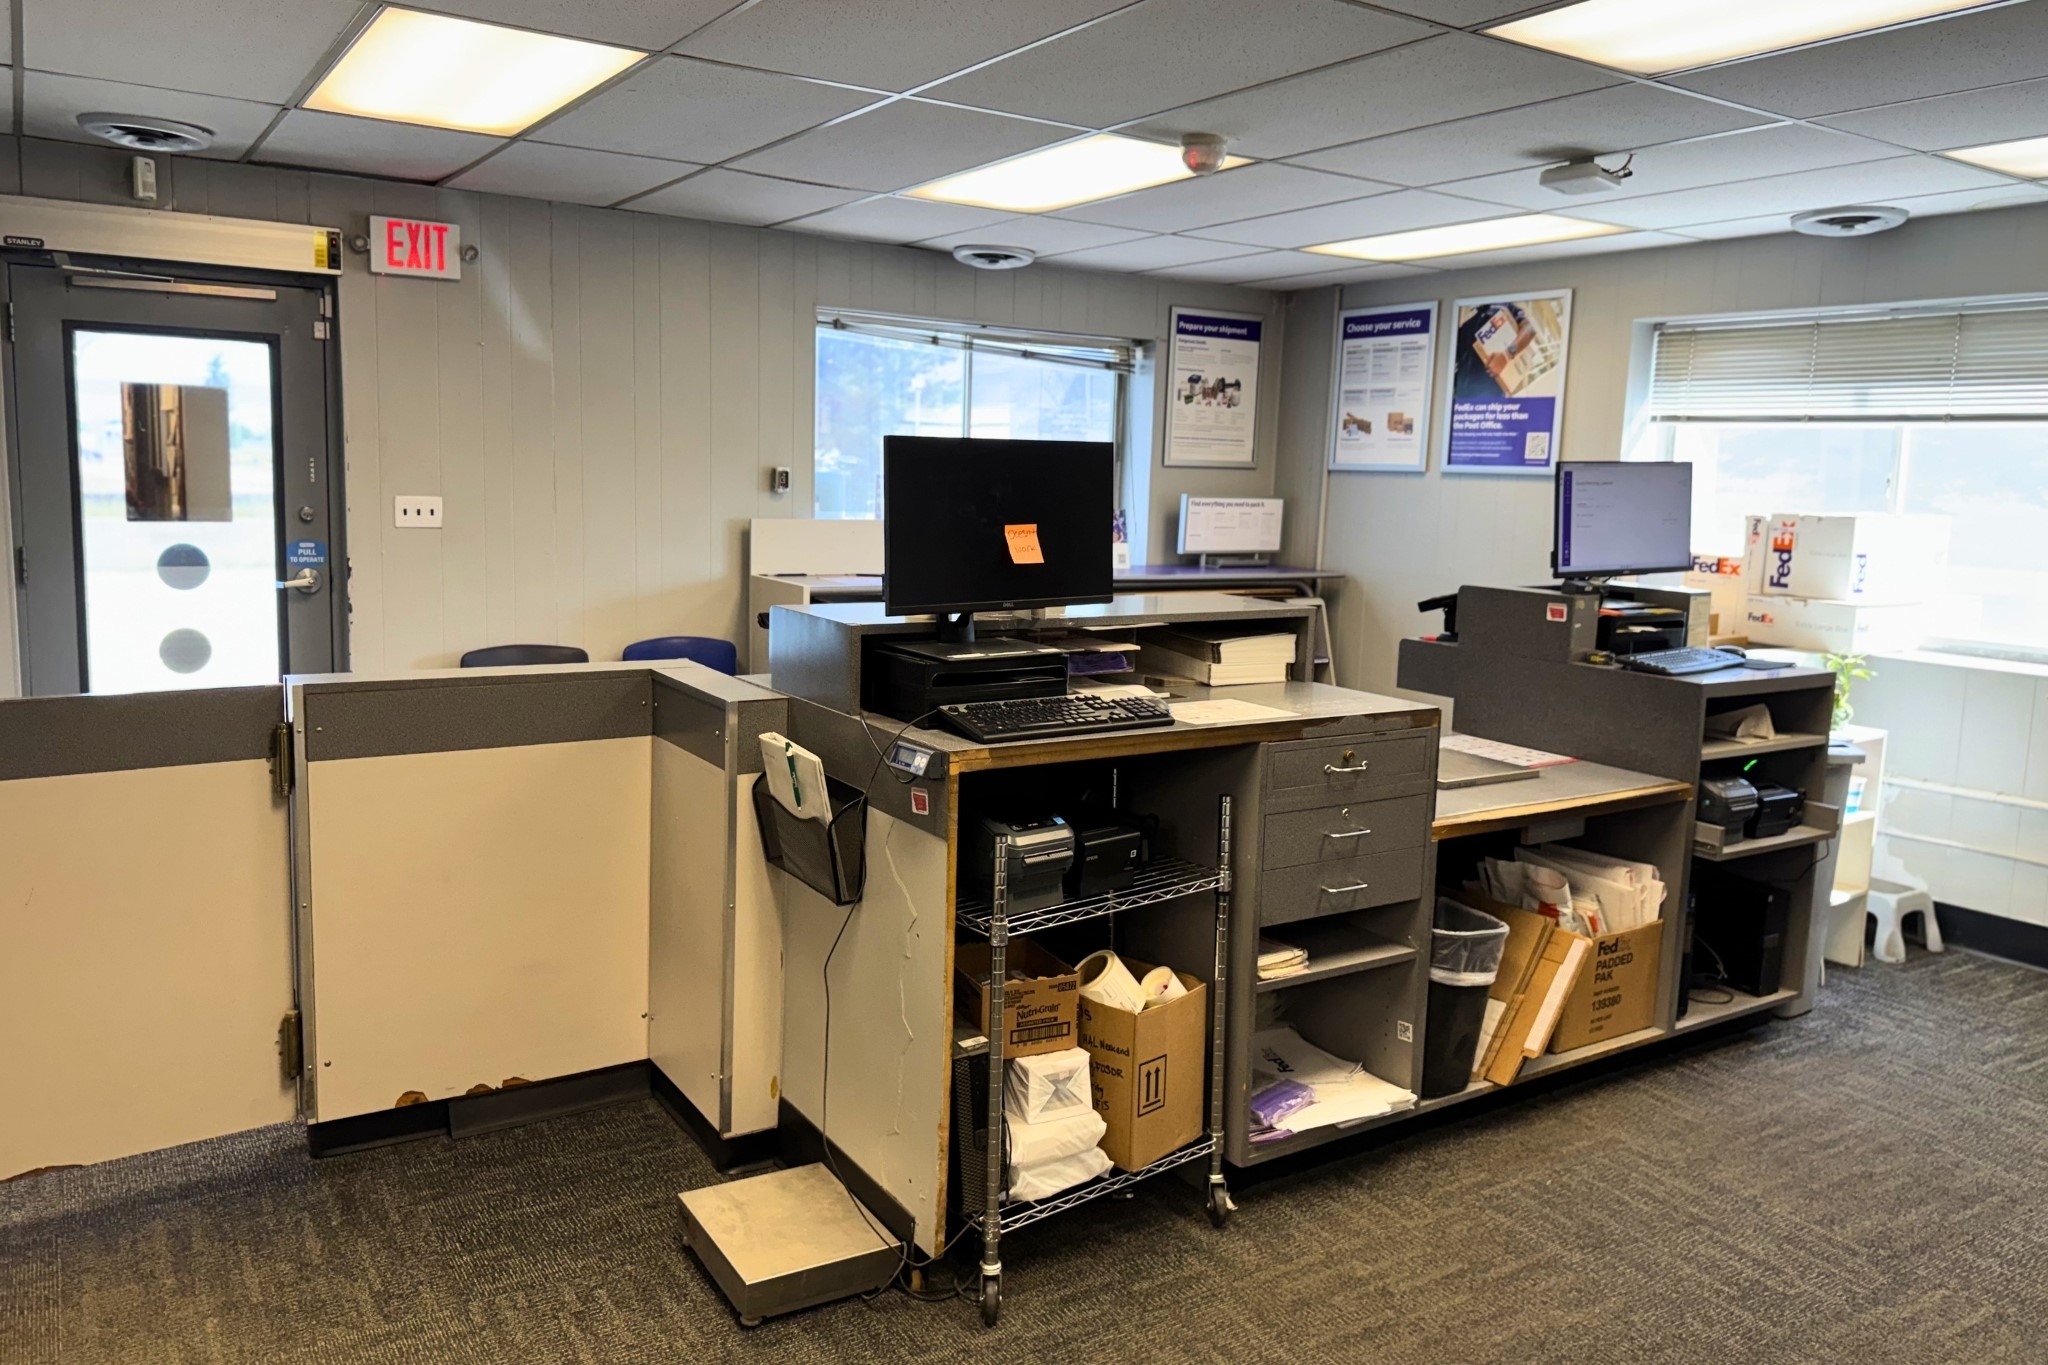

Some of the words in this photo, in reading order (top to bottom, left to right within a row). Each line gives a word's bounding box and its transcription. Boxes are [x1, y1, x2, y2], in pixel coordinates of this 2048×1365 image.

[7, 238, 41, 246] STANLEY
[387, 221, 448, 271] EXIT
[1179, 321, 1203, 332] Prepare
[1204, 325, 1218, 333] your
[1219, 325, 1248, 335] shipment
[1346, 323, 1374, 333] Choose
[1373, 322, 1392, 333] your
[1392, 318, 1422, 329] service
[1477, 315, 1506, 344] FedEx
[1454, 403, 1474, 411] FedEx
[1488, 403, 1502, 412] ship
[1503, 403, 1520, 412] your
[1453, 412, 1484, 421] packages
[1496, 412, 1511, 420] less
[1511, 412, 1529, 420] than
[1453, 421, 1464, 429] the
[1464, 421, 1479, 429] Post
[298, 548, 317, 556] PULL
[1769, 521, 1796, 588] FedEx
[1692, 556, 1741, 576] FedEx
[1747, 612, 1774, 624] FedEx
[1595, 952, 1634, 971] PADDED
[1594, 970, 1613, 984] PAK
[1016, 1003, 1059, 1021] Nutri-Grain
